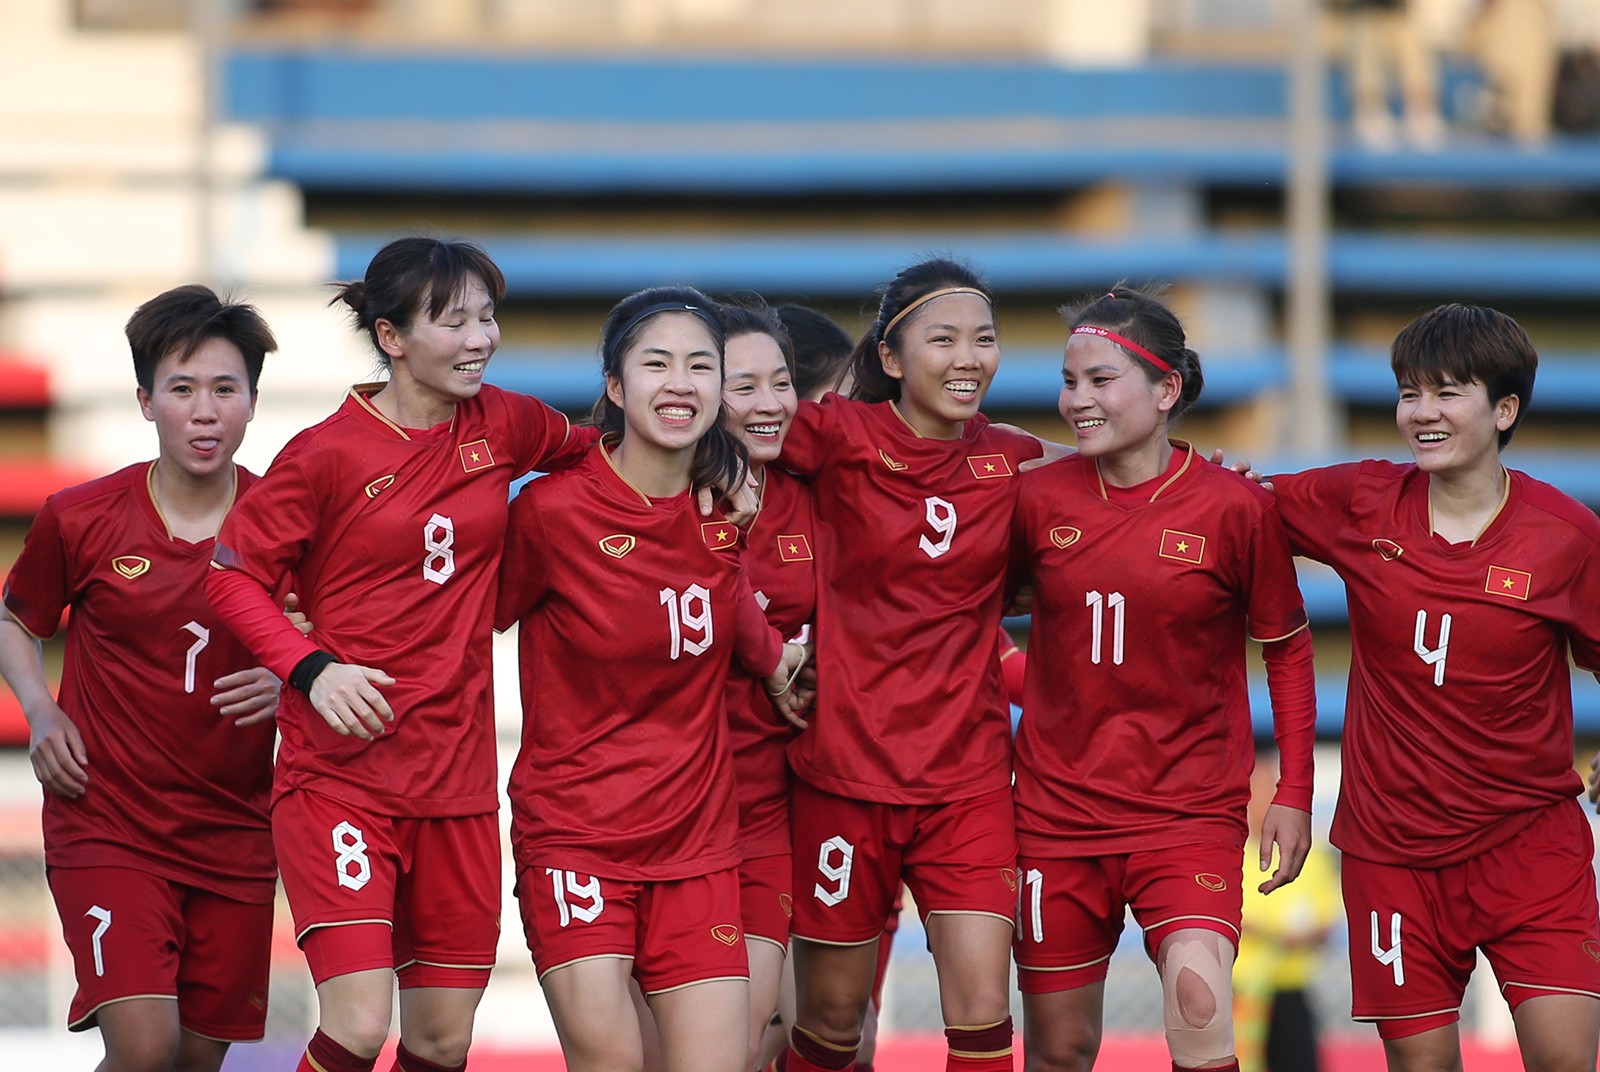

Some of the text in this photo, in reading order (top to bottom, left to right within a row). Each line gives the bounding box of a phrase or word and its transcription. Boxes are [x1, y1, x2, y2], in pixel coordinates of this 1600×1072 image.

[1075, 326, 1097, 334] adidas
[423, 513, 455, 584] 8
[919, 496, 957, 558] 9
[181, 621, 209, 693] 7
[660, 583, 713, 660] 19
[1085, 590, 1125, 665] 11
[1413, 610, 1451, 686] 4
[332, 821, 371, 891] 8
[814, 836, 854, 906] 9
[546, 867, 603, 927] 19
[83, 905, 111, 977] 7
[1370, 911, 1405, 986] 4
